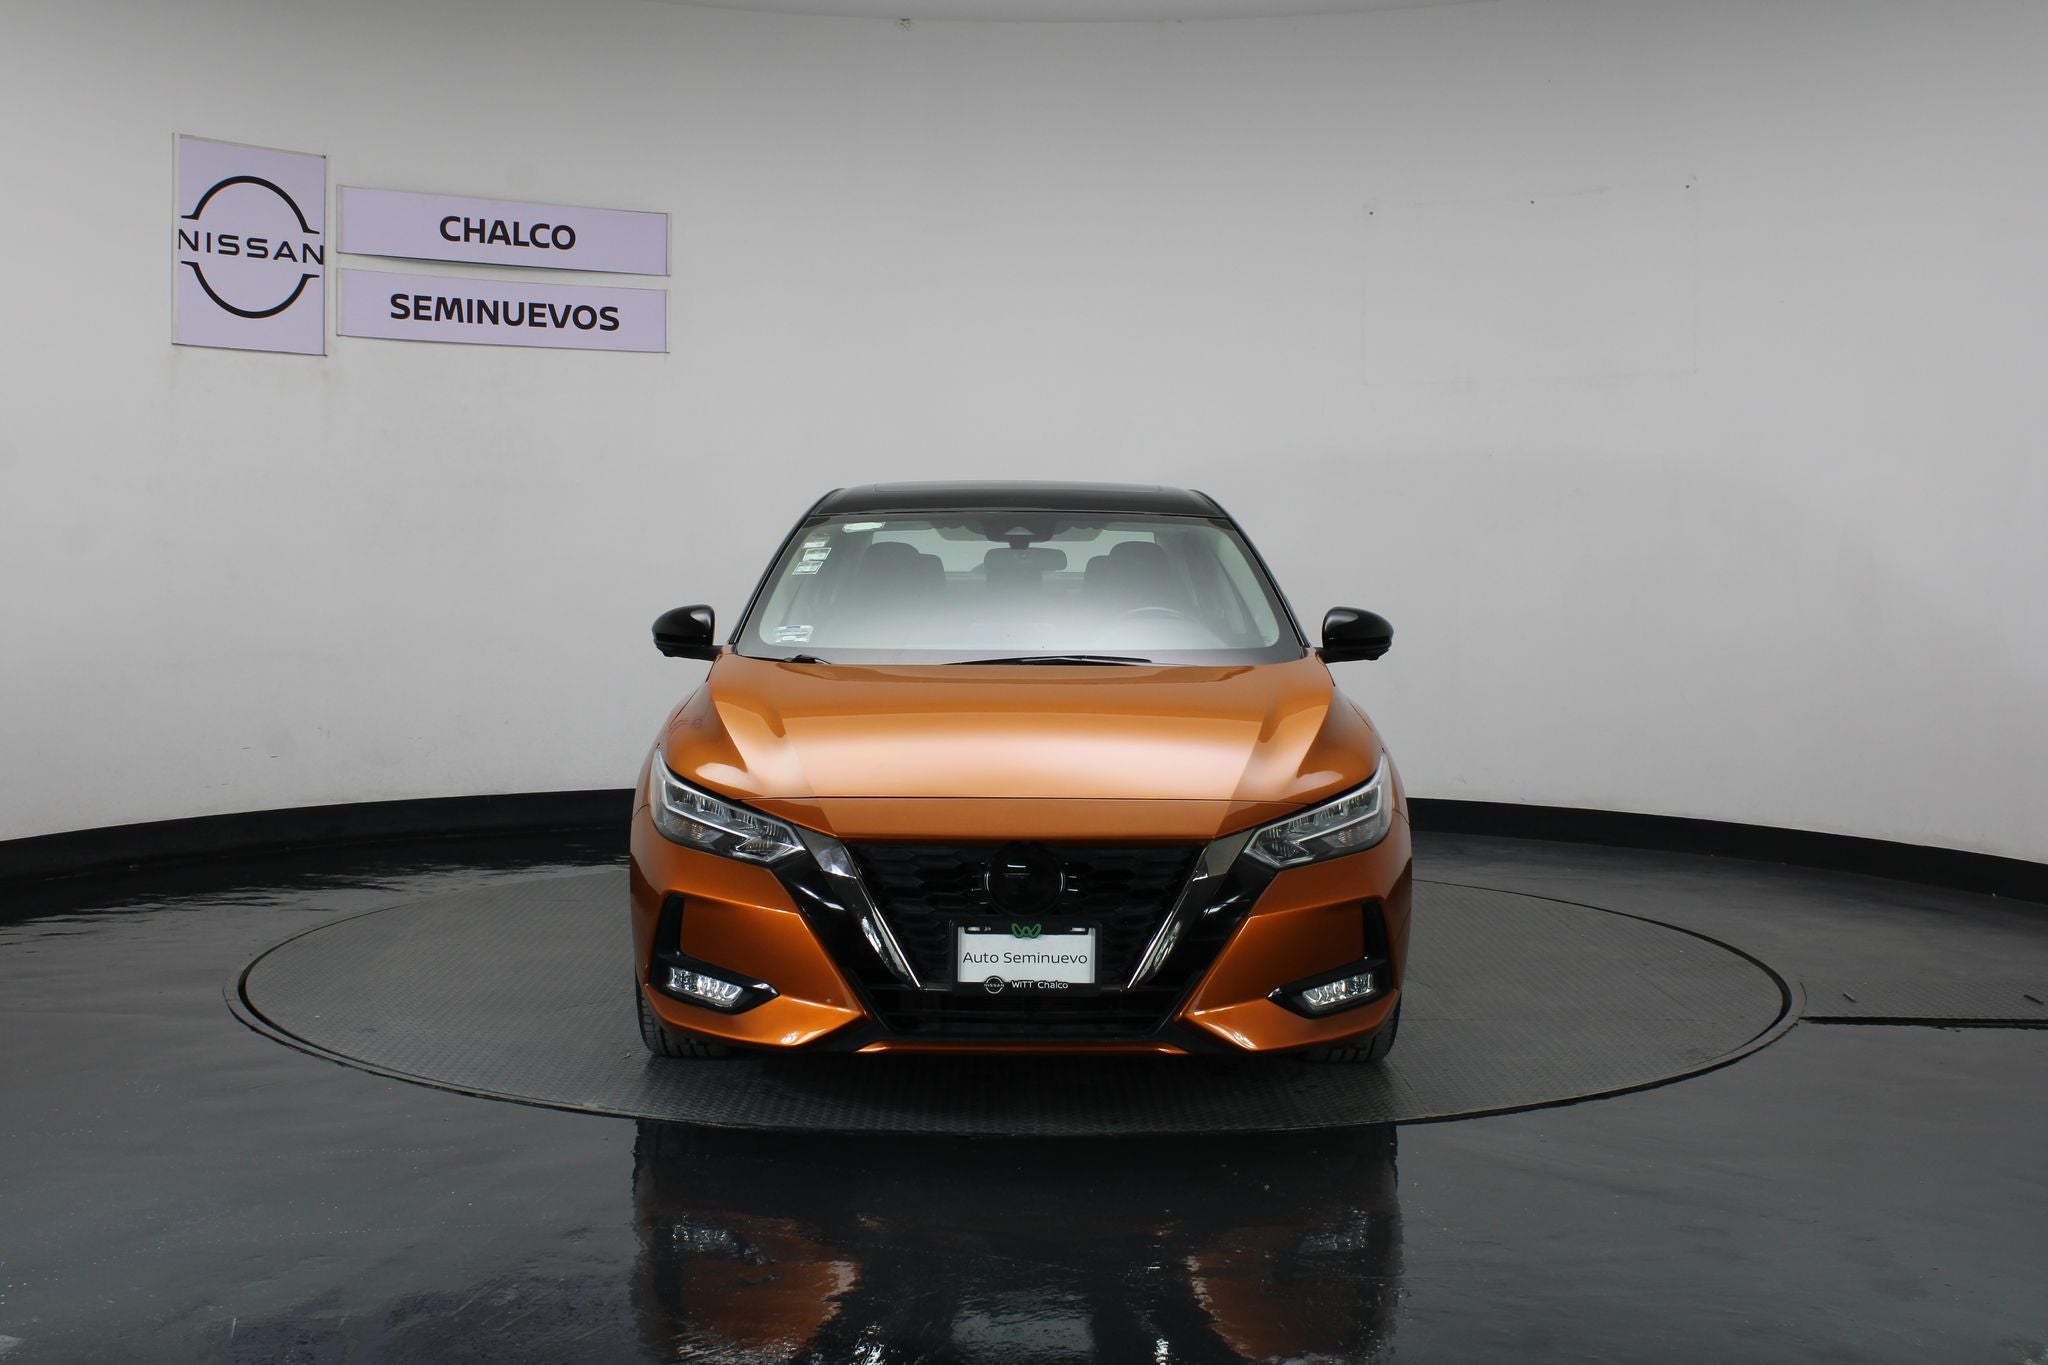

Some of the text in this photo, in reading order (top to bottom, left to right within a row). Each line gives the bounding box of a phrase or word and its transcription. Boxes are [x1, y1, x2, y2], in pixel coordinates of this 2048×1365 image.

[178, 228, 325, 266] NISSAN
[439, 215, 577, 251] CHALCO
[390, 293, 621, 332] SEMINUEVOS
[962, 952, 1088, 964] Auto Seminuevo
[1011, 980, 1069, 990] WITT Chalco
